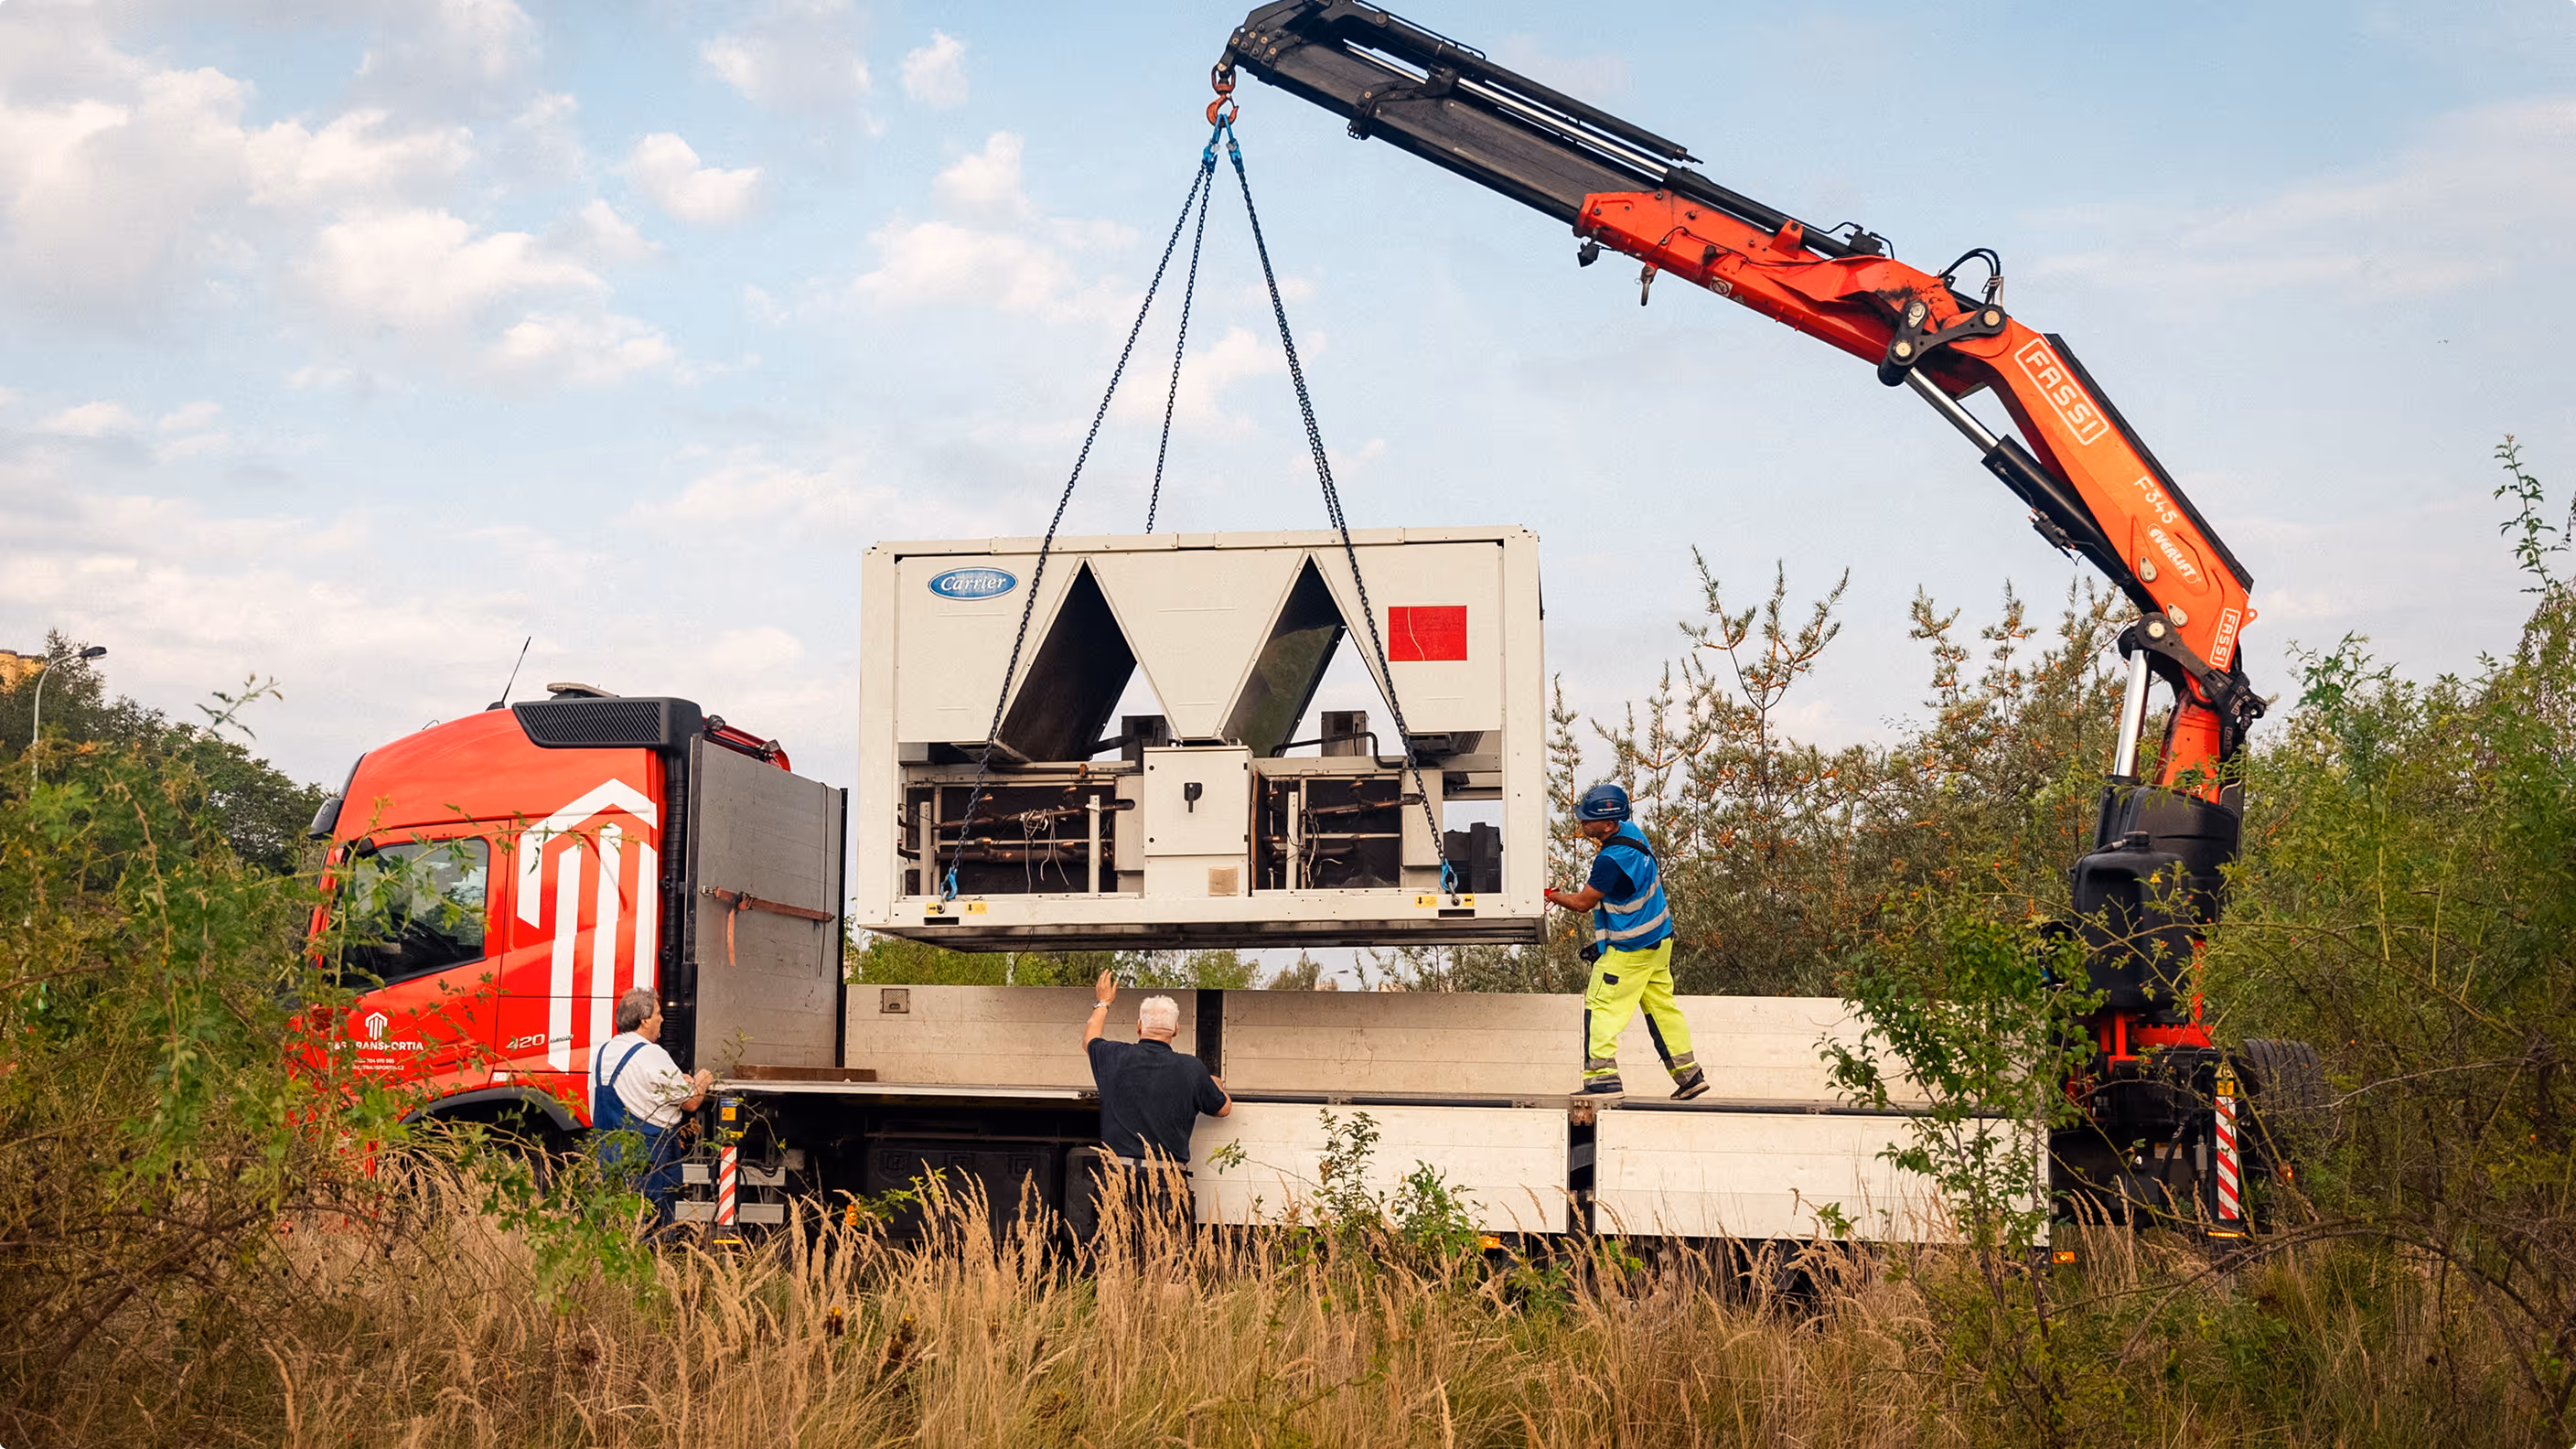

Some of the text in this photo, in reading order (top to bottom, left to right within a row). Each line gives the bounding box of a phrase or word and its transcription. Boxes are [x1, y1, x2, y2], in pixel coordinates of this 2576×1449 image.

[2025, 350, 2098, 434] FASSI
[2133, 475, 2178, 524] F345
[940, 575, 1007, 591] Carrier
[2214, 613, 2237, 662] FASSI
[349, 1041, 424, 1051] RANSPORTIA
[505, 1033, 546, 1050] 420
